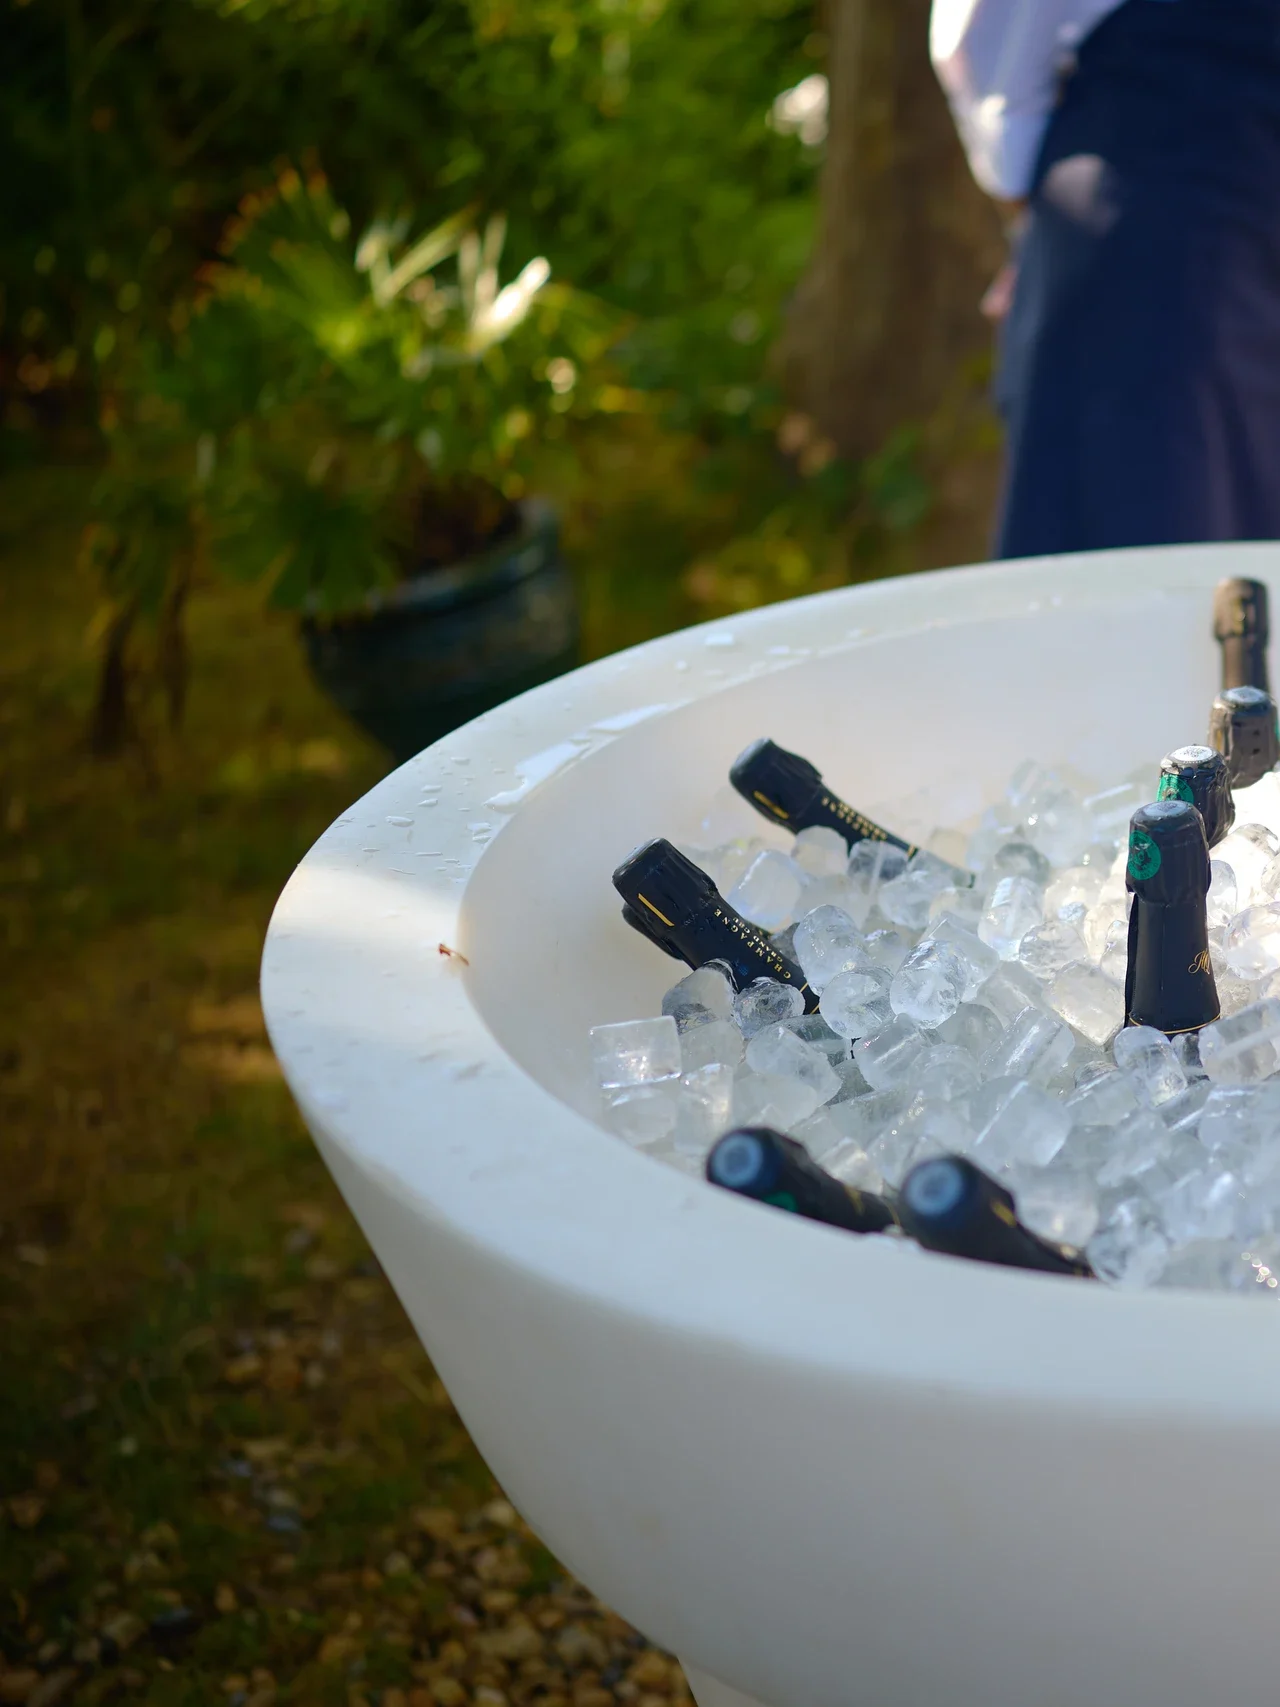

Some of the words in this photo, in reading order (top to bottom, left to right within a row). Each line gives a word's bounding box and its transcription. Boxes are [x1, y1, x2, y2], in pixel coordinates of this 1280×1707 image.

[732, 916, 751, 934] CRU
[713, 908, 792, 979] CHAMPAGNE
[752, 935, 783, 963] GRAND
